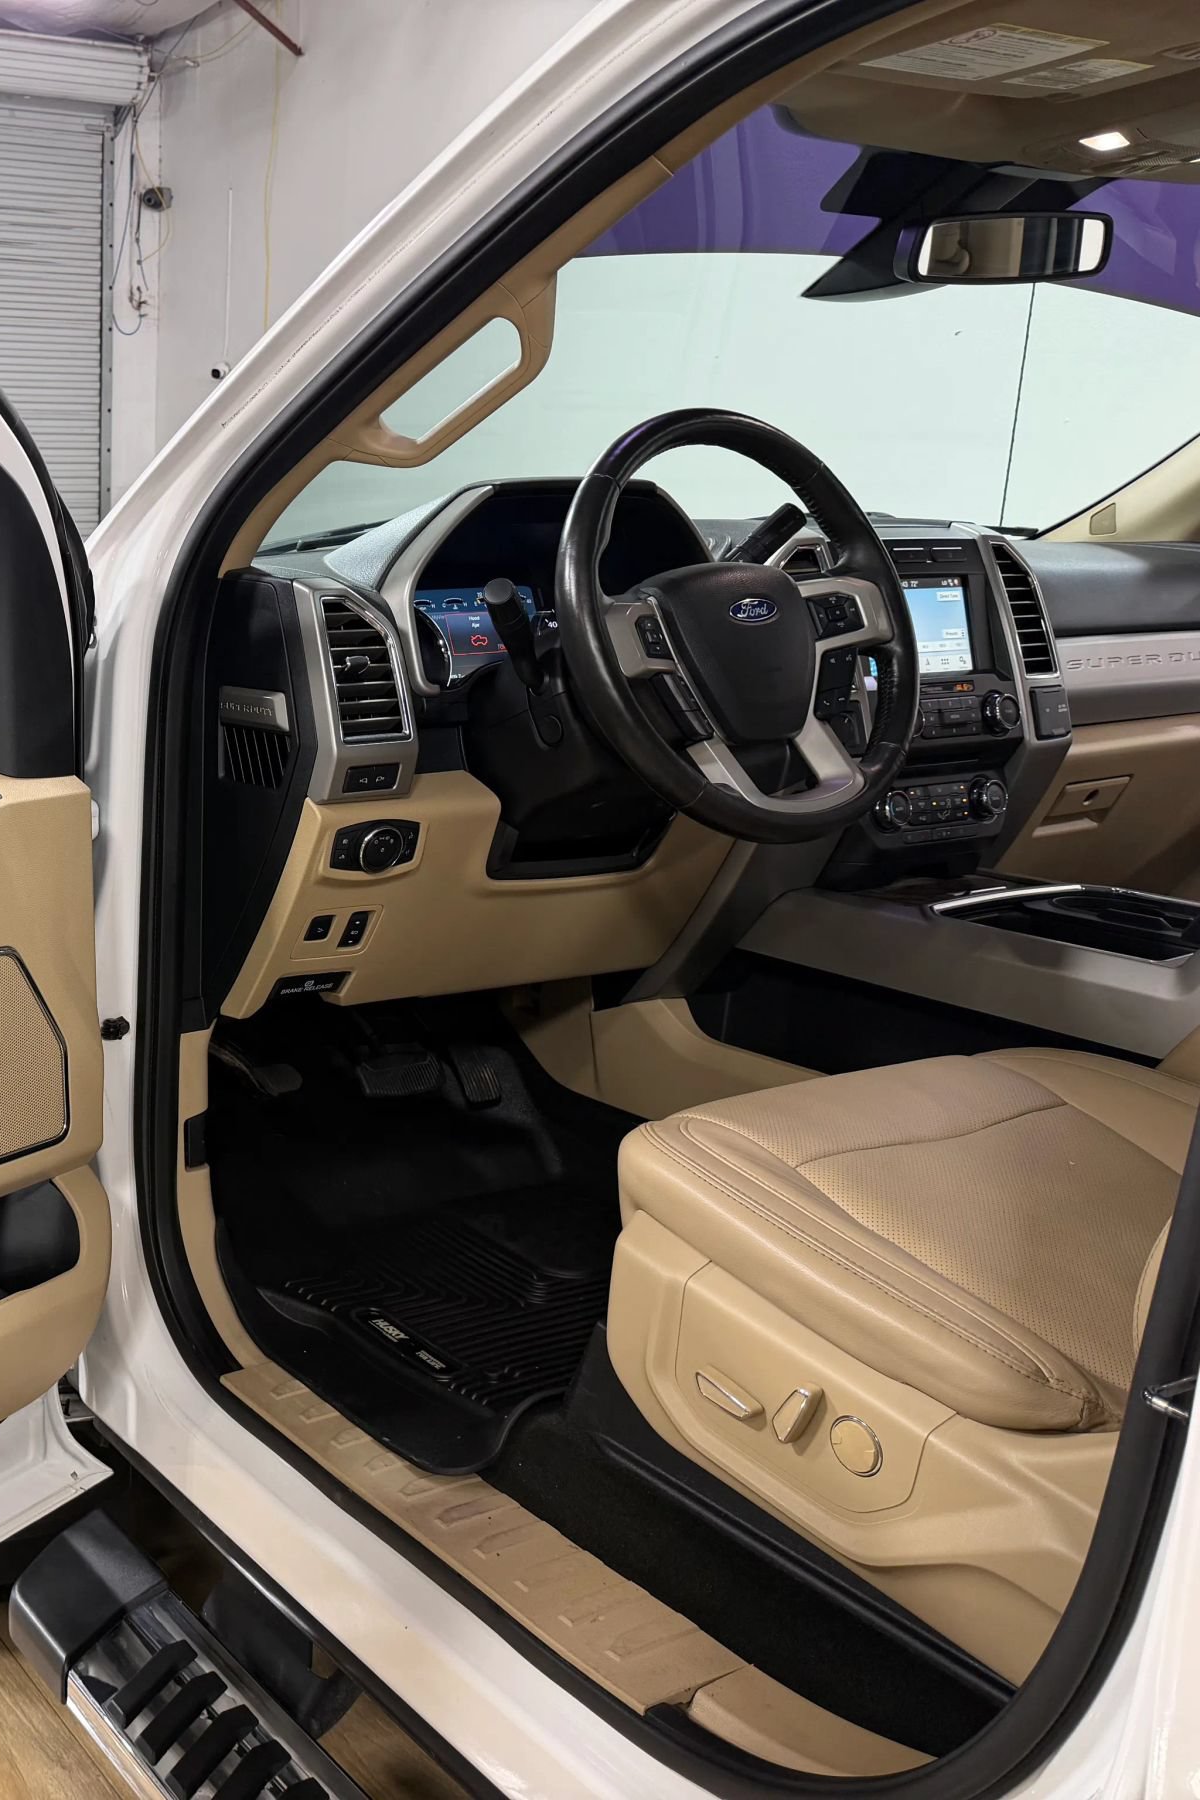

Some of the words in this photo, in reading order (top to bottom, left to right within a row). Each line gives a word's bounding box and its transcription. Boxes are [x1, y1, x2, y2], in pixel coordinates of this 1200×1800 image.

[737, 600, 769, 618] Ford
[1066, 654, 1162, 670] SUPER
[304, 983, 334, 991] RELEASE
[371, 1319, 410, 1340] HUSKY
